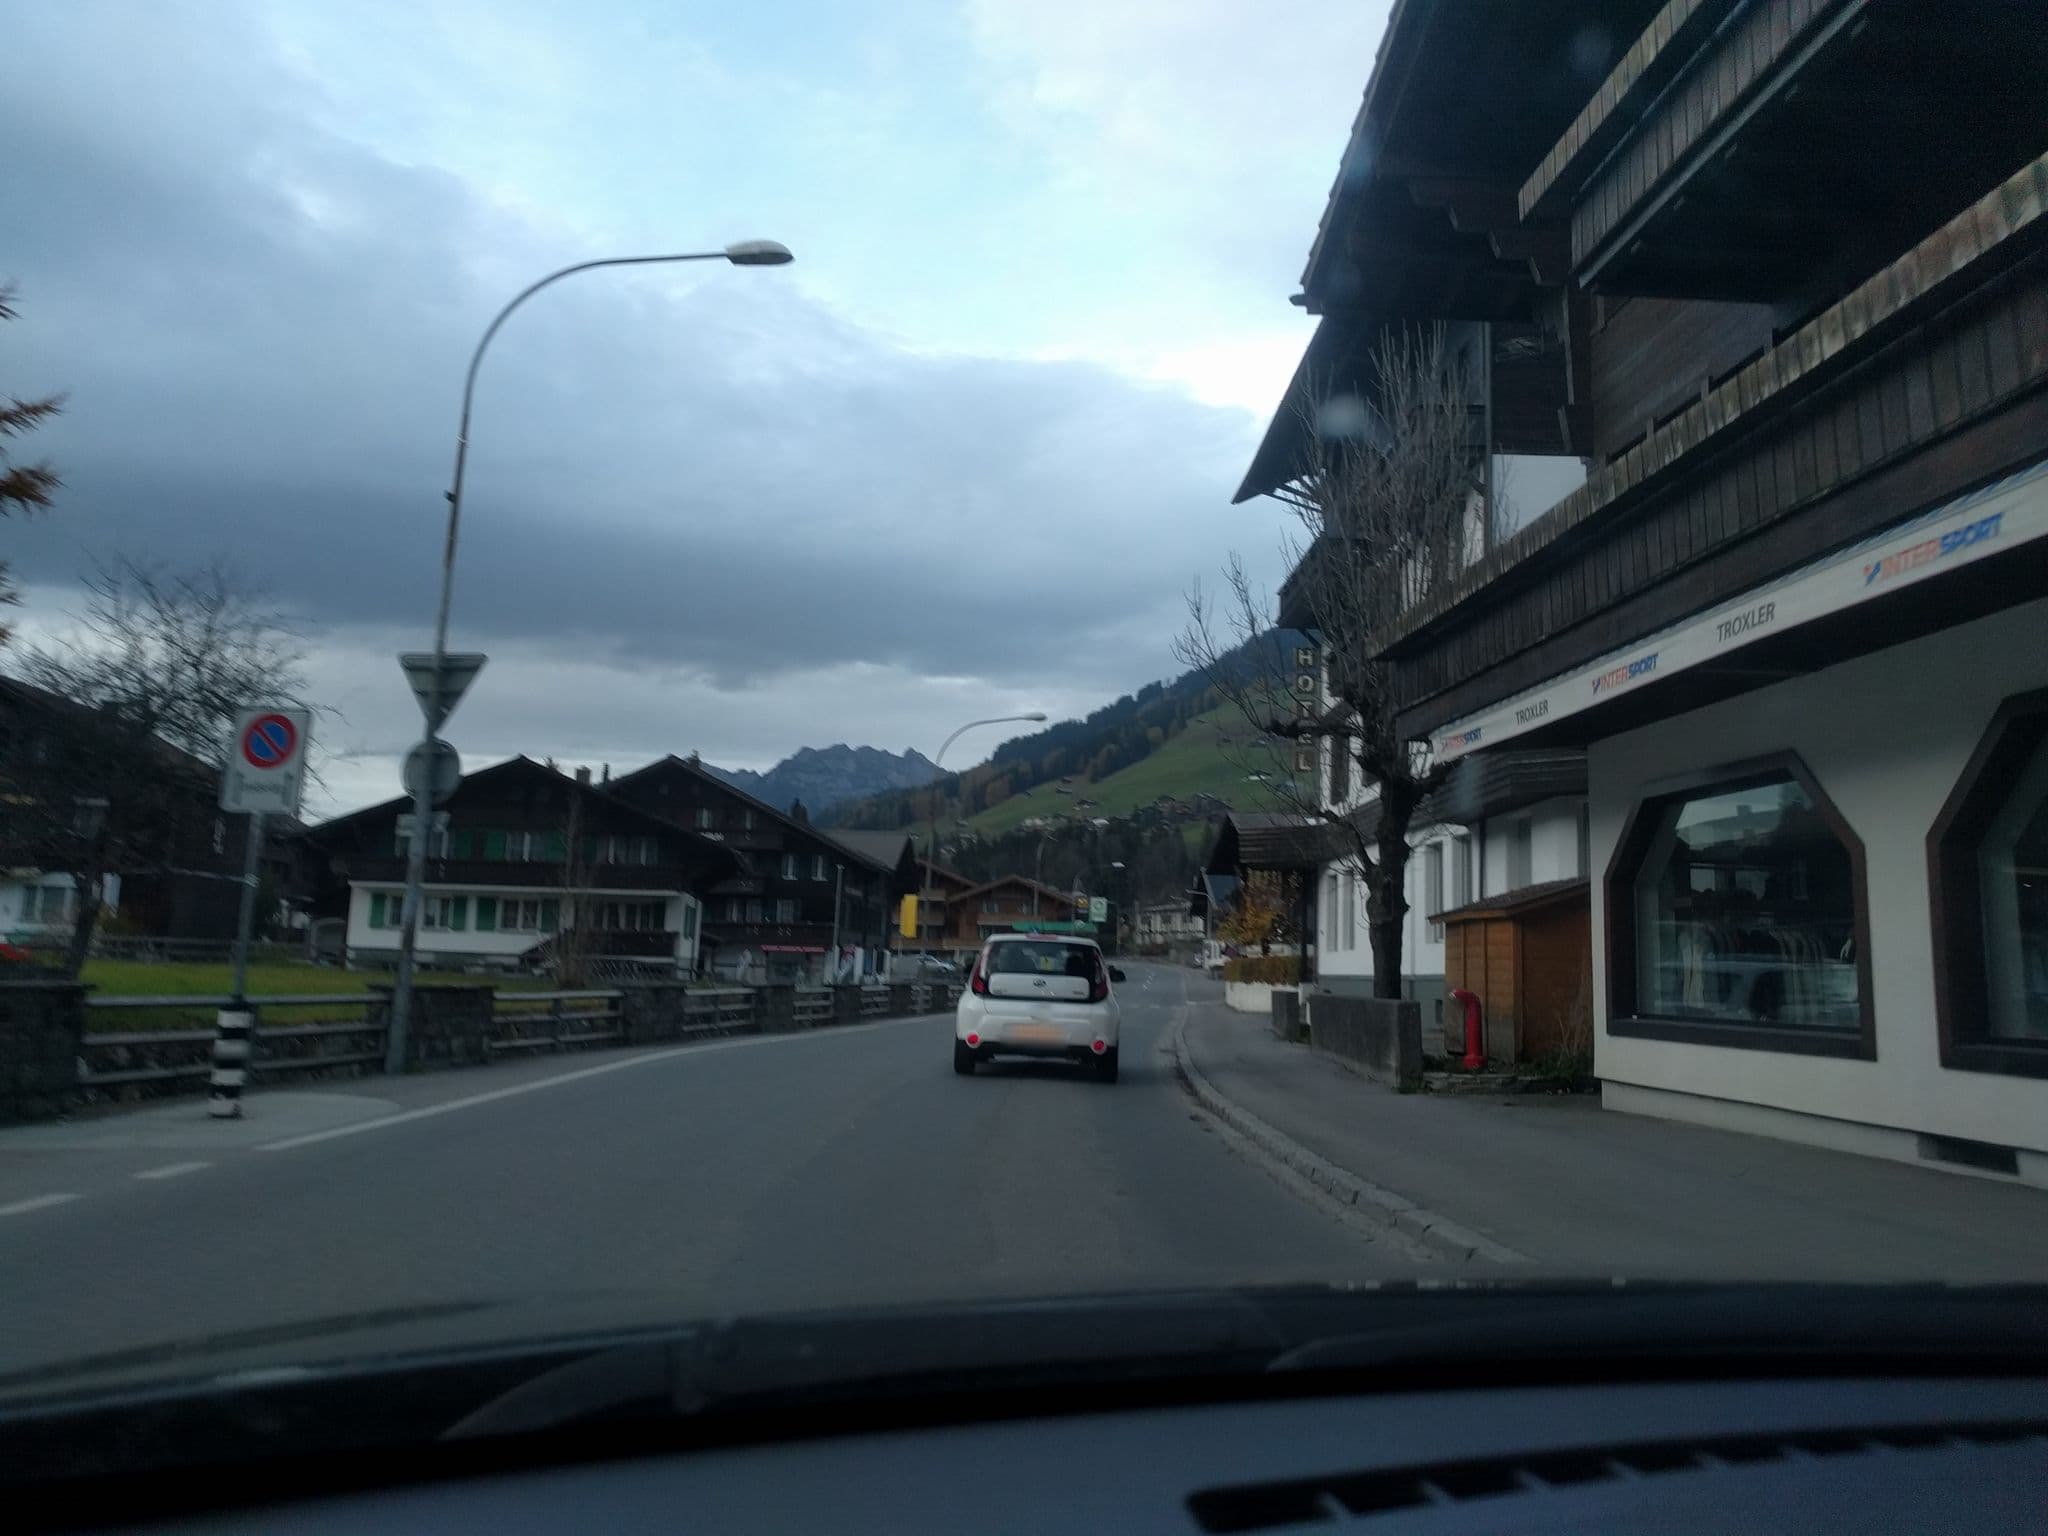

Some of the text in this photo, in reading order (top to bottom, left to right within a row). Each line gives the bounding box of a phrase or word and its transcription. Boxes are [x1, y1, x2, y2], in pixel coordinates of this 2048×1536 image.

[1716, 602, 1777, 642] TROXLER
[1600, 652, 1659, 692] INTERSPORT
[1515, 699, 1549, 725] TROXLER
